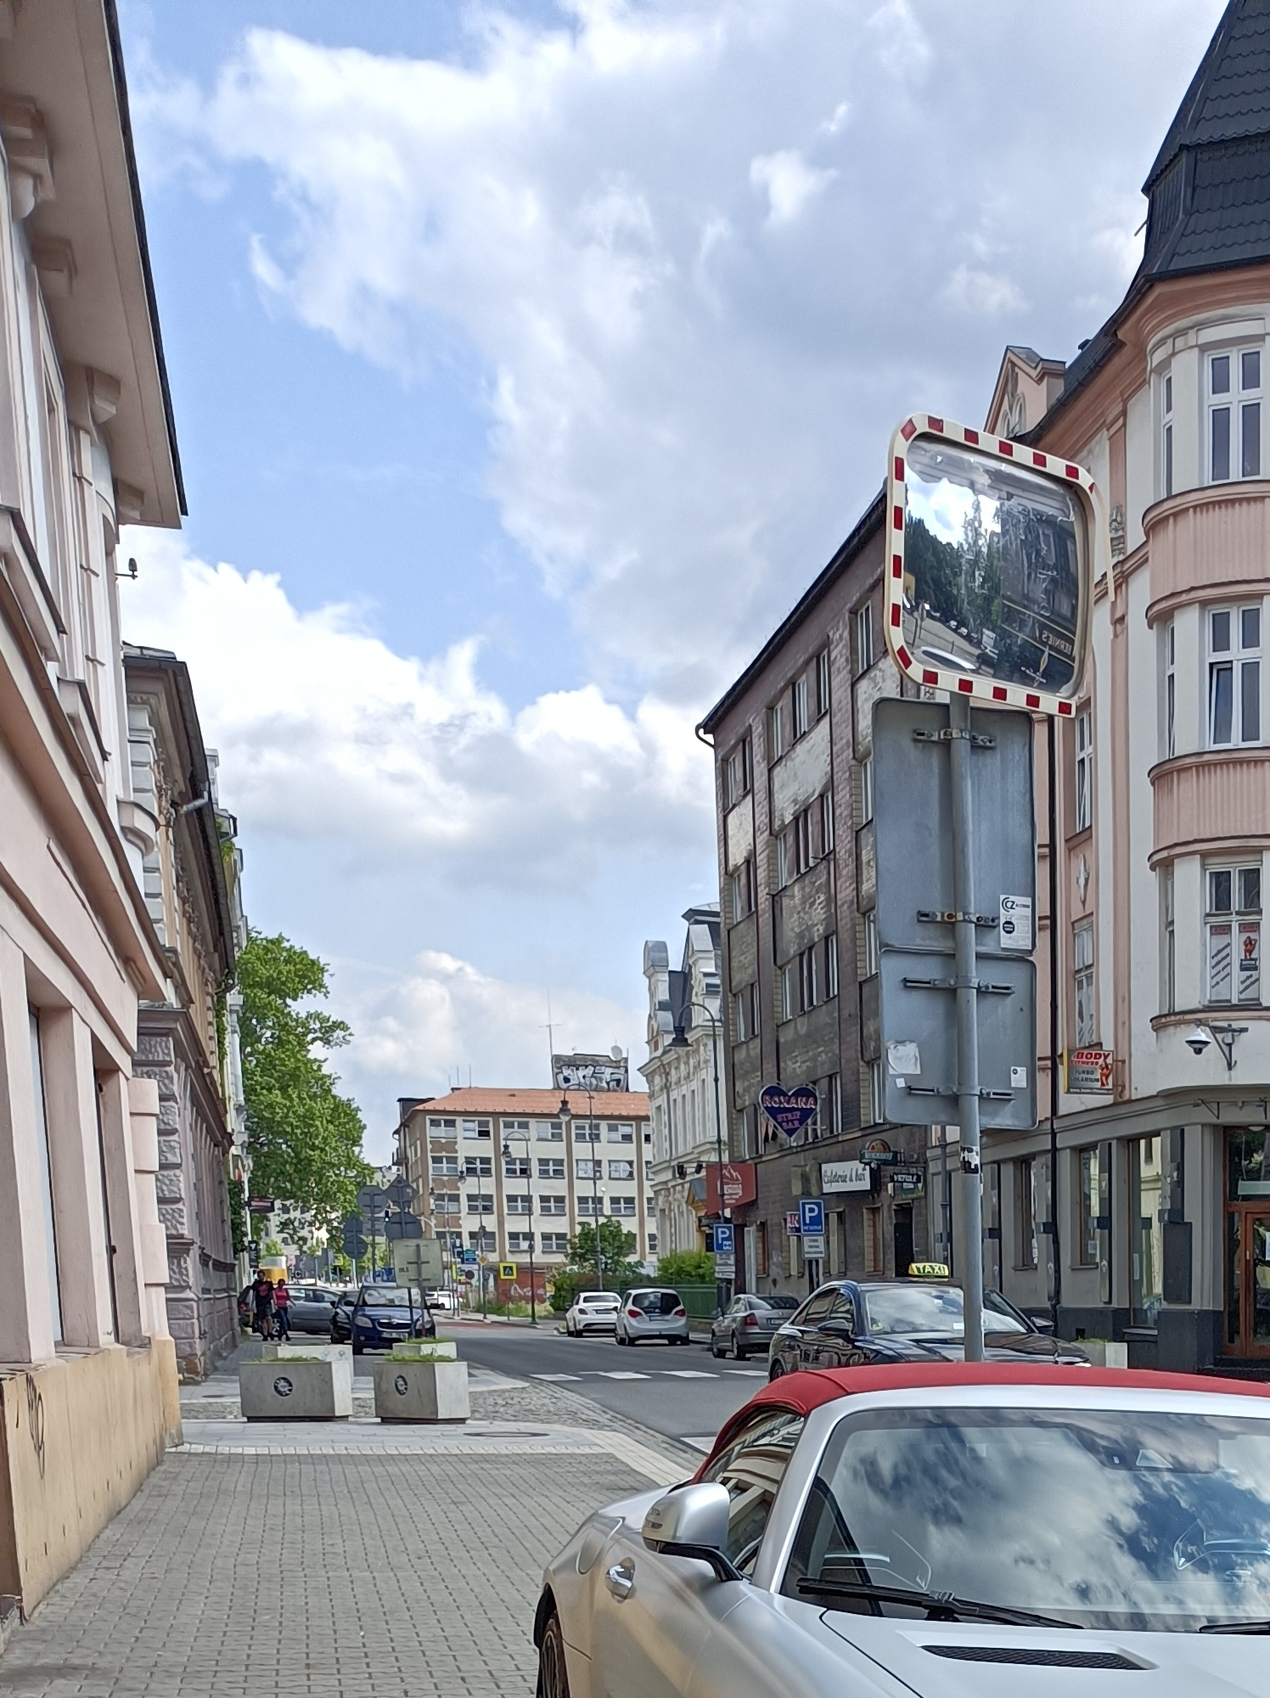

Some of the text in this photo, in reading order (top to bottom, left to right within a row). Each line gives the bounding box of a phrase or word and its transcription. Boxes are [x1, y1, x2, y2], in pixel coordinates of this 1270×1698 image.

[762, 1094, 816, 1108] ROXANA
[804, 1204, 819, 1224] P
[717, 1227, 730, 1244] P
[914, 1264, 947, 1275] TAXI
